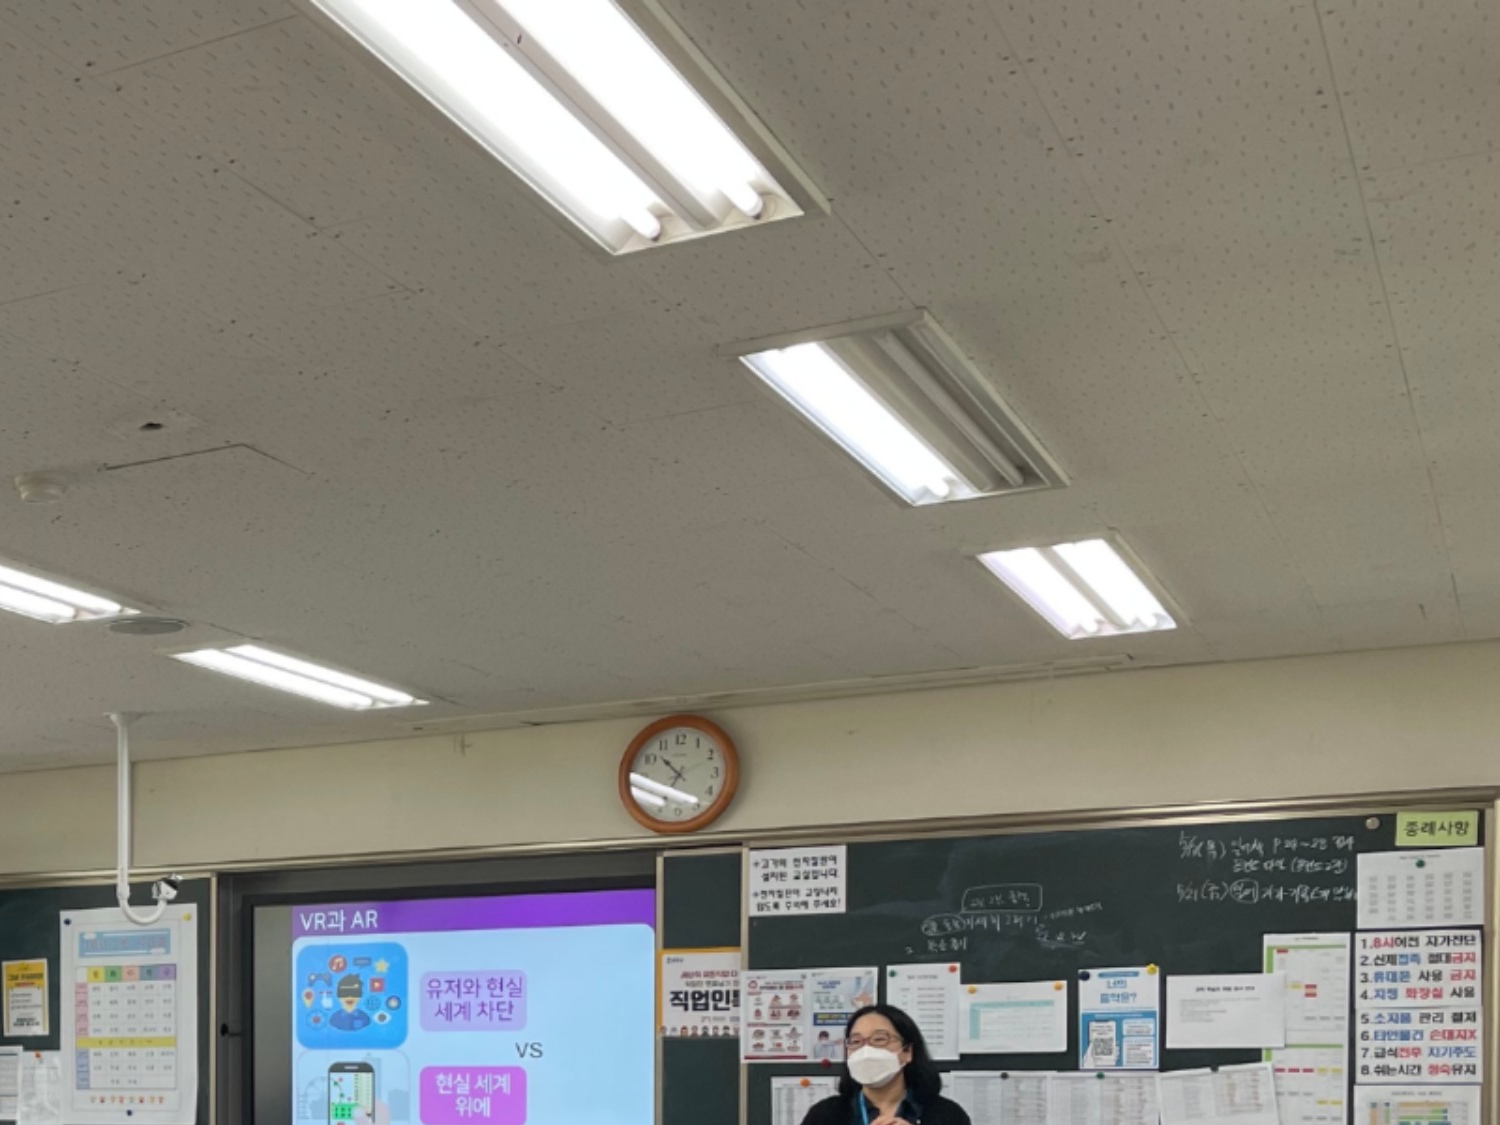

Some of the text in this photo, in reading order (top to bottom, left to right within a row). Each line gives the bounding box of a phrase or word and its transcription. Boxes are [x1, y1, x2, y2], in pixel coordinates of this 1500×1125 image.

[1404, 821, 1470, 837] 종례사항
[300, 910, 378, 933] VR과 AR
[1426, 935, 1477, 946] 자가진단
[1428, 952, 1476, 964] 절대금지
[1418, 970, 1443, 981] 사용
[1450, 969, 1476, 981] 금지
[426, 977, 523, 999] 유저와 현실
[1406, 987, 1443, 999] 화장실
[1451, 986, 1475, 998] 사용
[434, 1001, 514, 1022] 세계 차단
[1419, 1012, 1444, 1024] 관리
[515, 1041, 543, 1059] VS
[1428, 1046, 1477, 1058] 자기주도
[436, 1072, 511, 1095] 현실 세계
[455, 1097, 491, 1118] 위에
